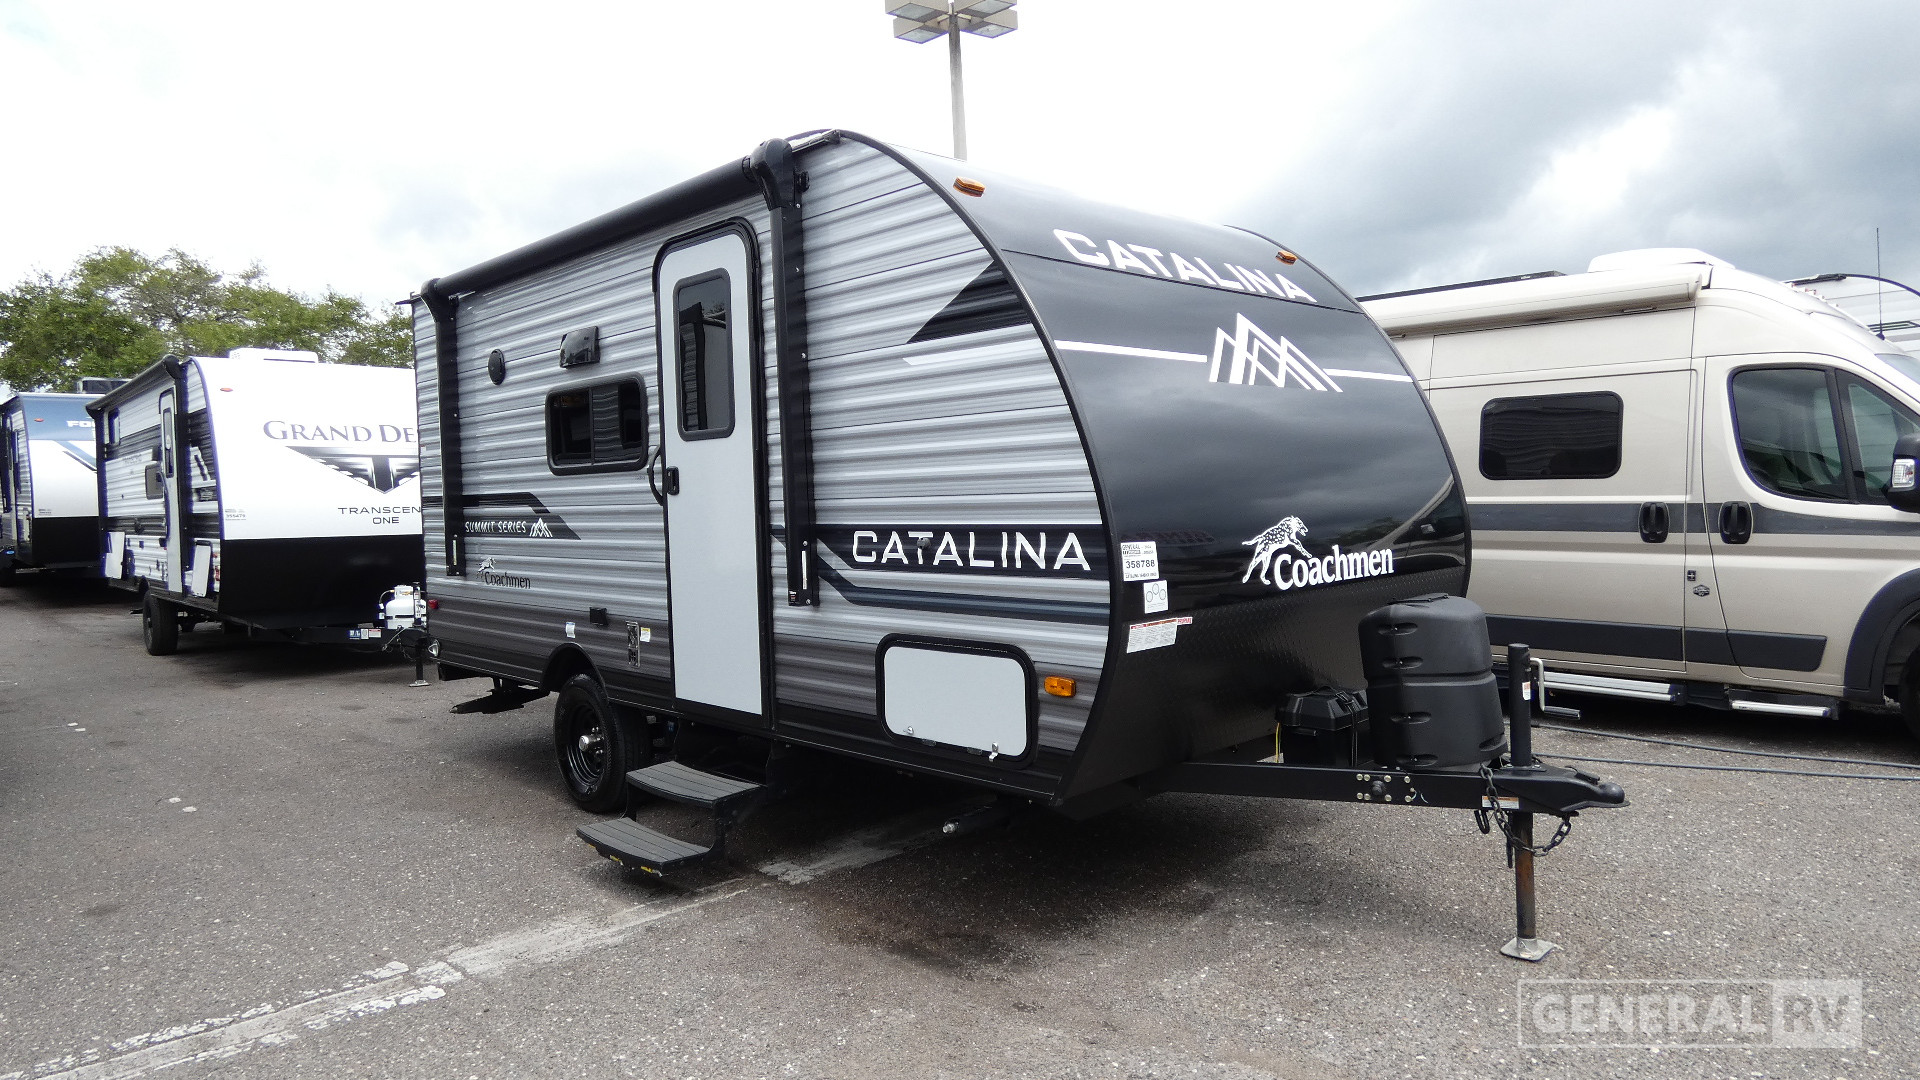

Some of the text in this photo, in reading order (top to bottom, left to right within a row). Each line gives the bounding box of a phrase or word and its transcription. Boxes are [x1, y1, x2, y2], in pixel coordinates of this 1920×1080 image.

[1053, 228, 1318, 303] CATALINA
[66, 420, 96, 428] FO
[263, 420, 417, 443] GRAND DE
[337, 506, 422, 515] TRANSCEN
[372, 517, 400, 525] ONE
[464, 520, 527, 533] SUMMIT SERIES
[852, 530, 1092, 571] CATALINA
[1273, 544, 1395, 591] Coachmen
[484, 571, 531, 589] Coachmen
